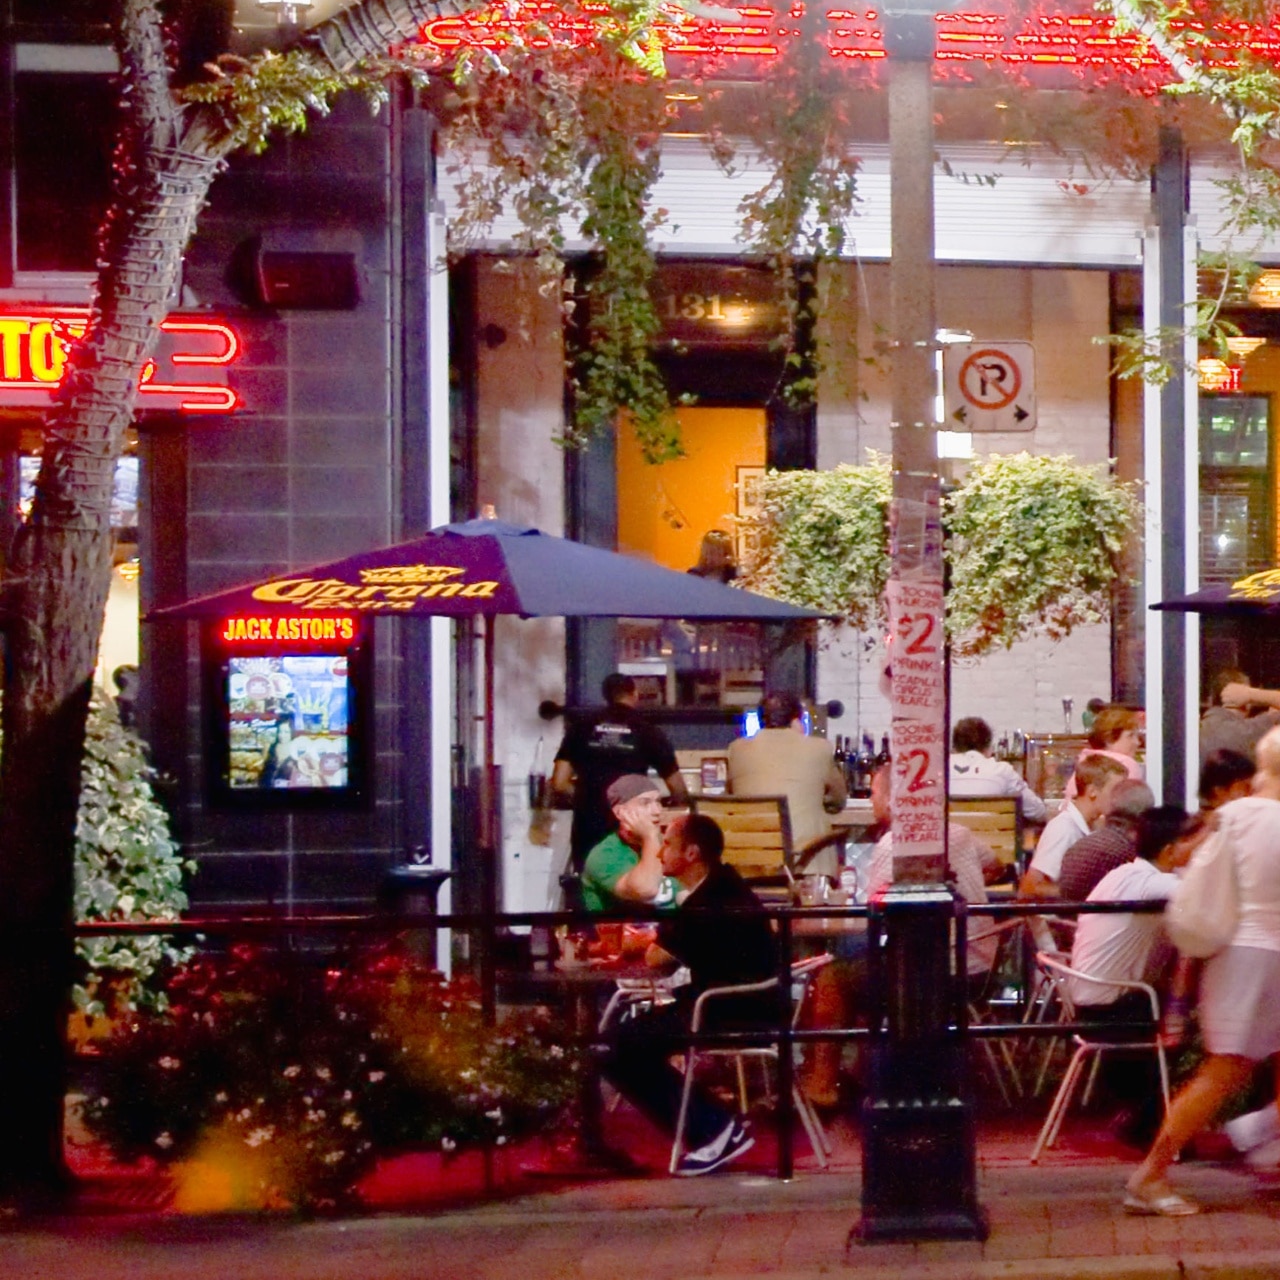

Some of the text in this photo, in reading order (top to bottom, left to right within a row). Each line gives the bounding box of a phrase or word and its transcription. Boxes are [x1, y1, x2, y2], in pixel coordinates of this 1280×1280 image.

[251, 578, 499, 604] Corona
[301, 597, 416, 610] Extra
[223, 617, 354, 641] JACK ASTOR'S
[898, 613, 937, 655] $2
[897, 749, 936, 793] $2
